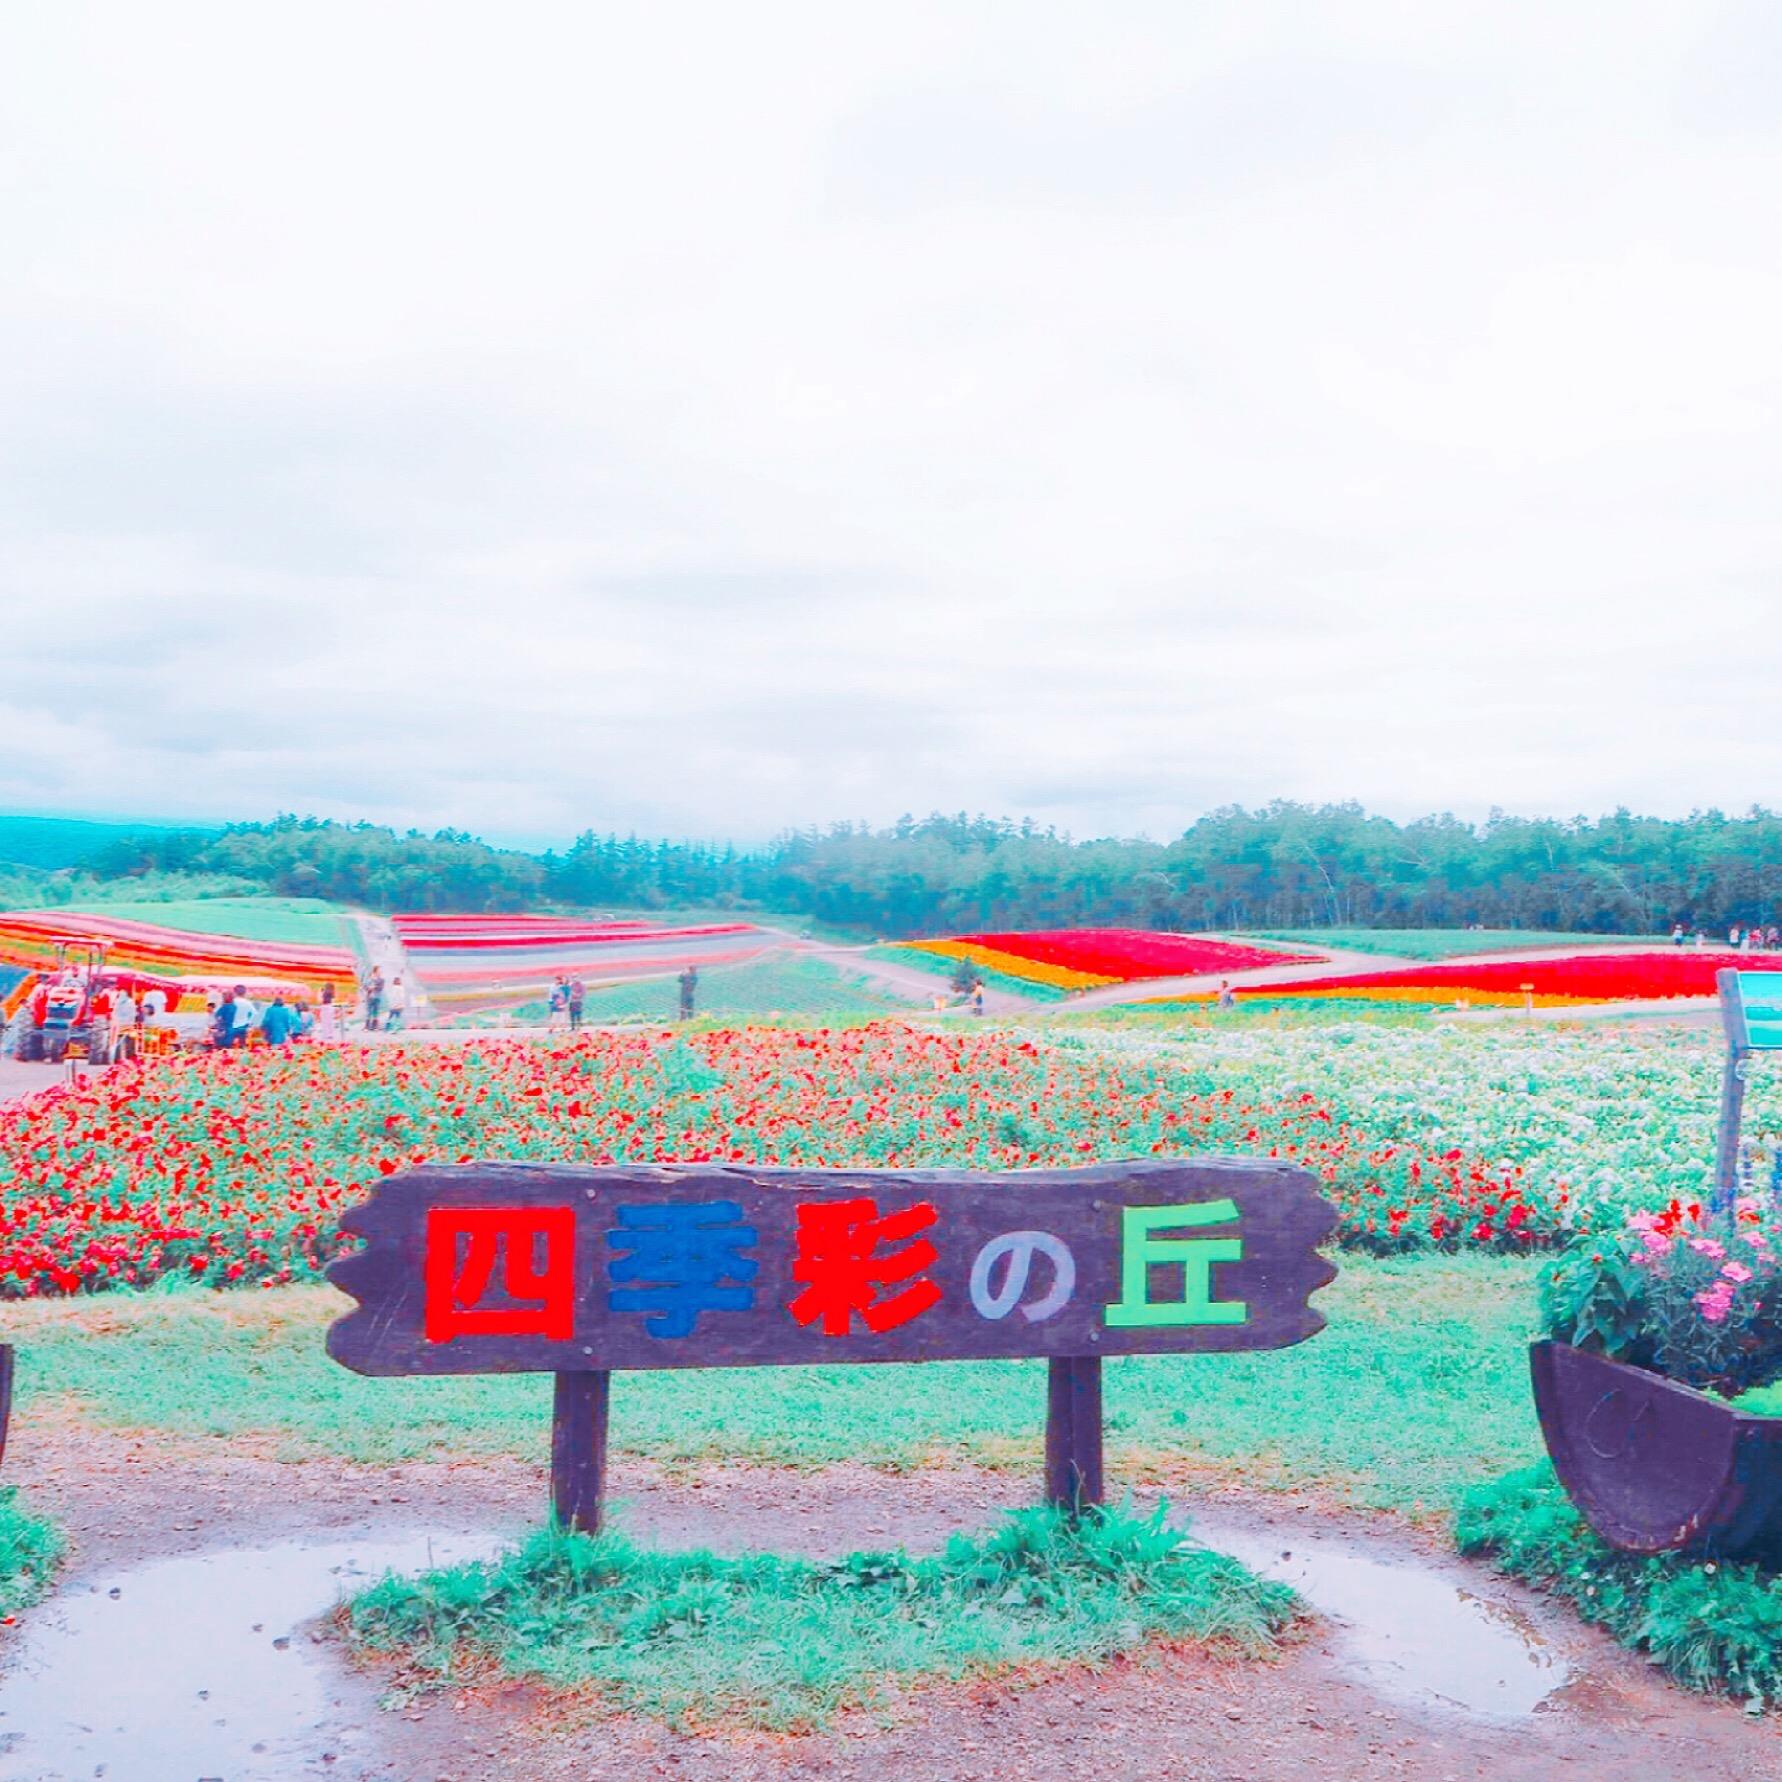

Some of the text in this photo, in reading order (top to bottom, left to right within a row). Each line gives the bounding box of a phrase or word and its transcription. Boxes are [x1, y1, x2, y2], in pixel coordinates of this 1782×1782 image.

[424, 1198, 1247, 1344] 四季彩の丘
